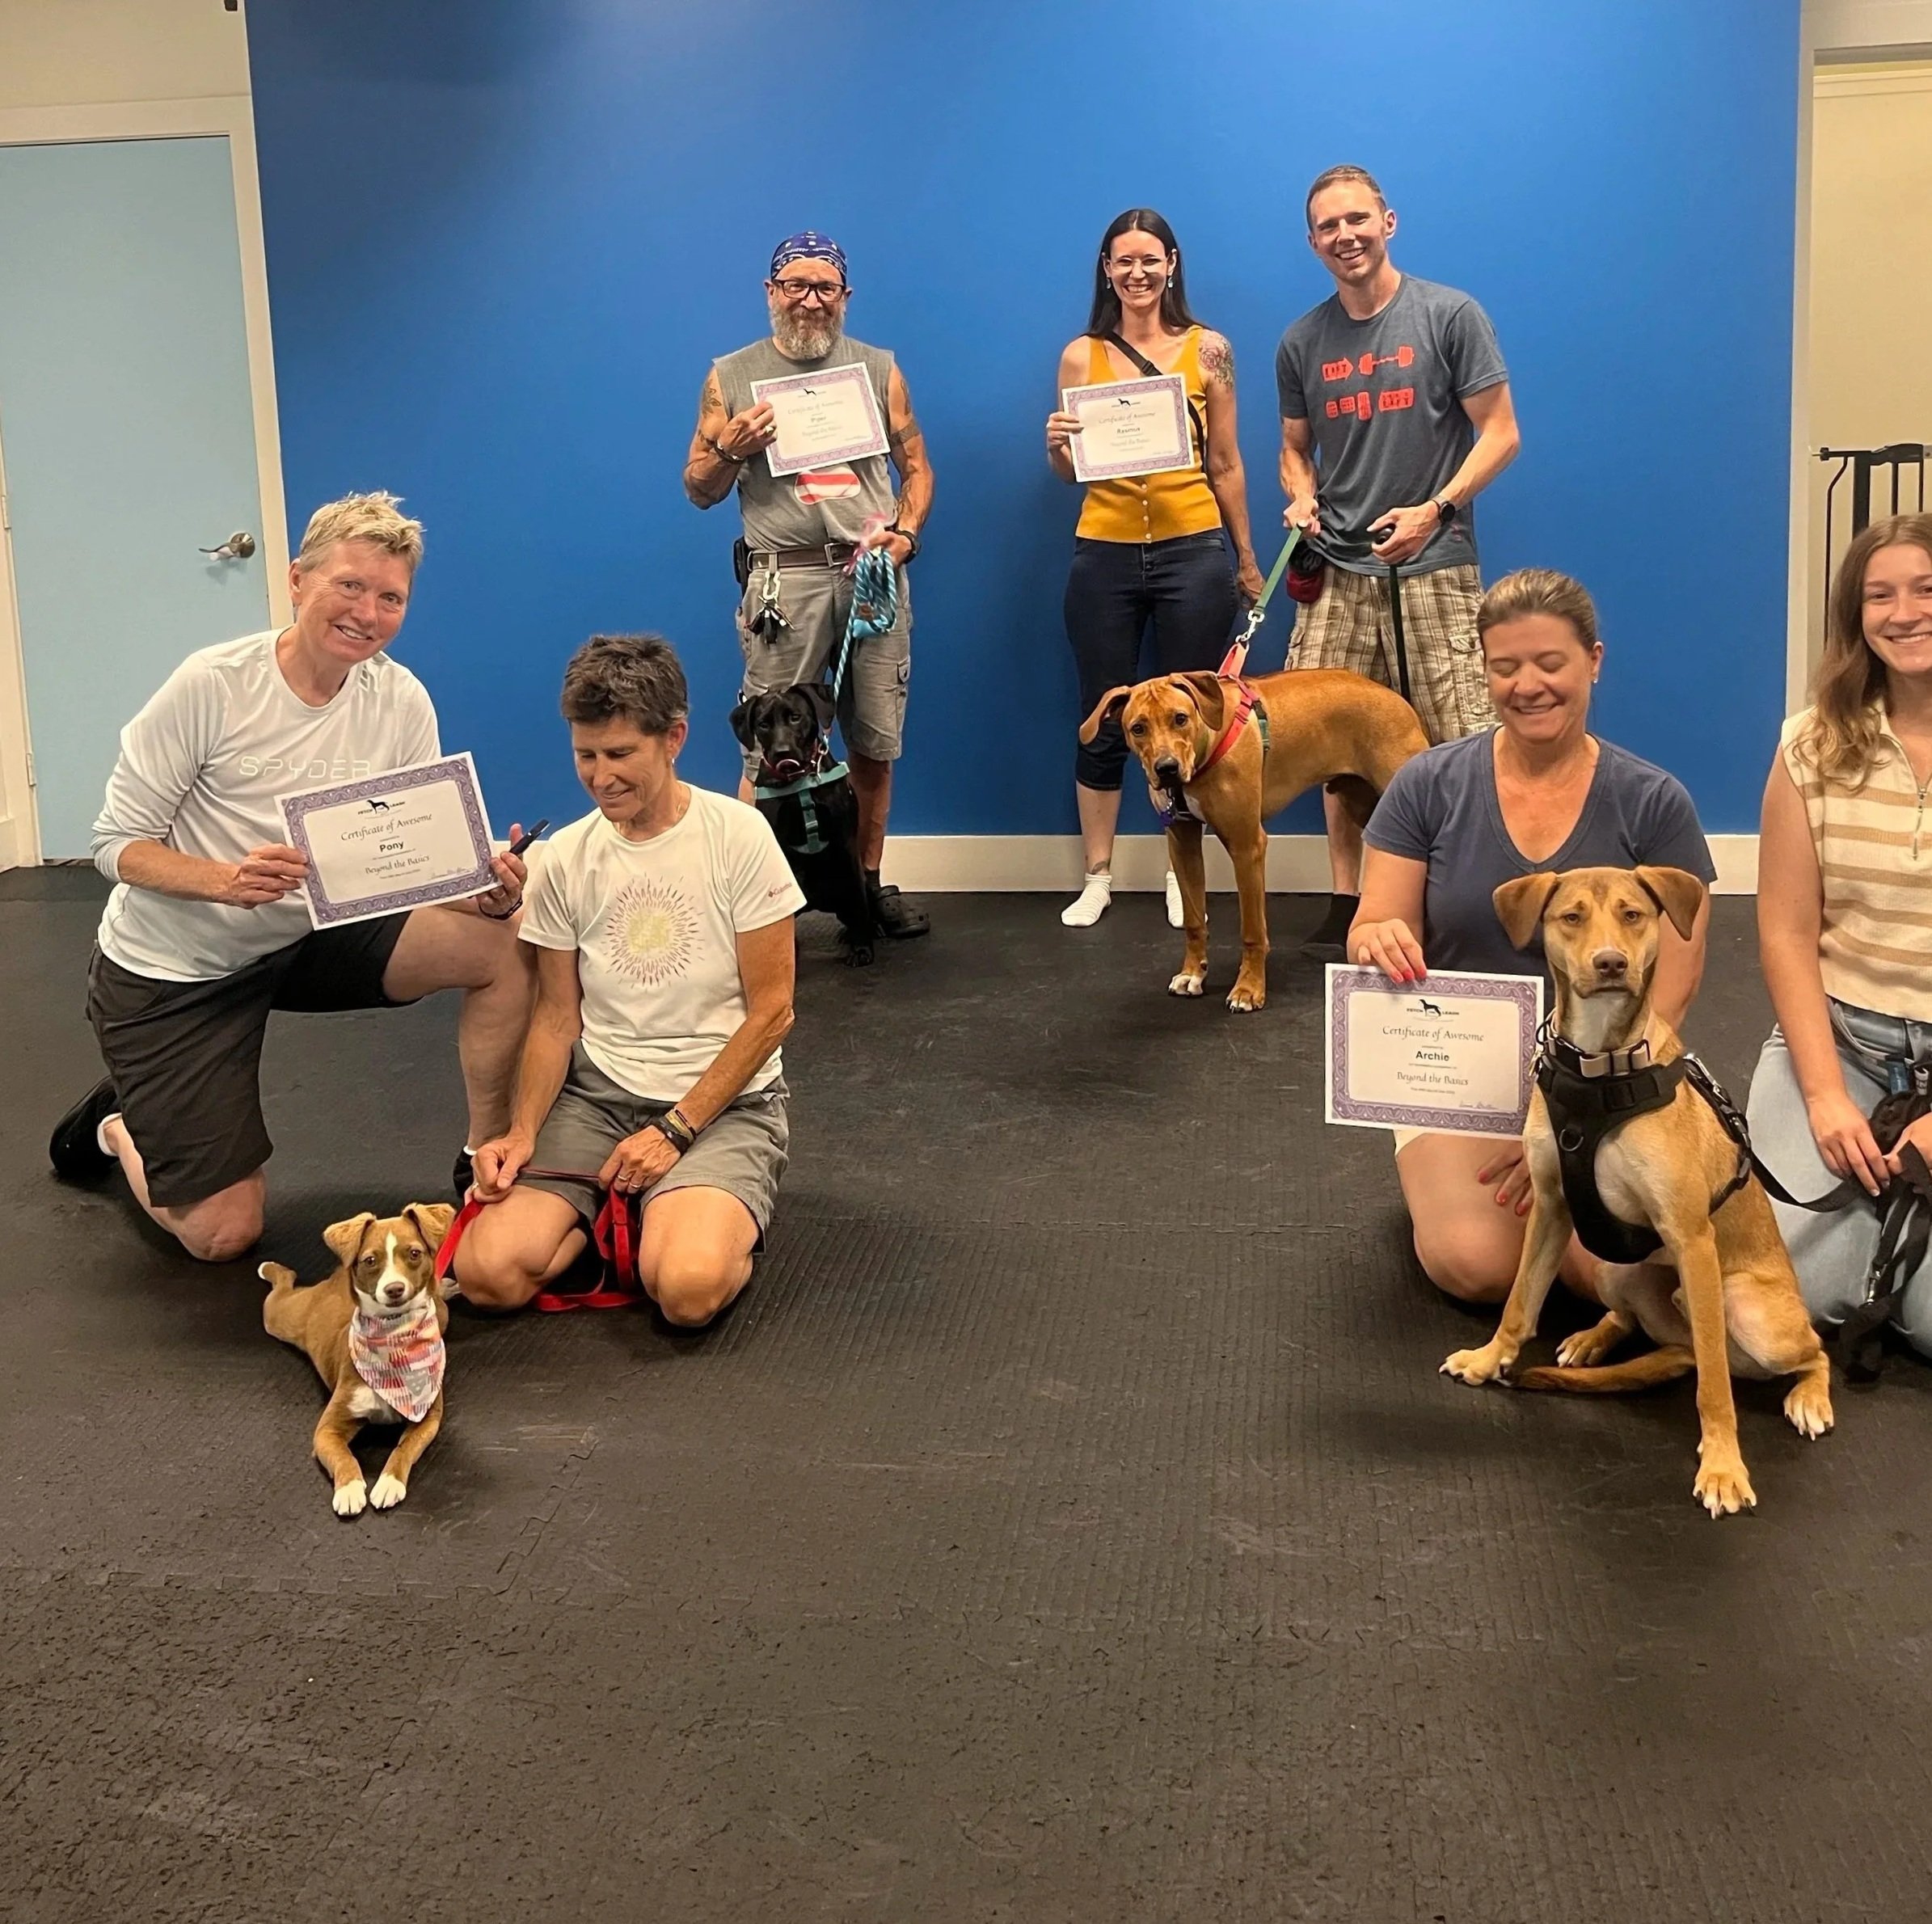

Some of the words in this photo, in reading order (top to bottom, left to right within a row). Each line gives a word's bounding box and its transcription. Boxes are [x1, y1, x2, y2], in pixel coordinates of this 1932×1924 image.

[238, 755, 371, 779] SPYDER
[340, 825, 384, 841] Certificate
[386, 818, 395, 833] of
[396, 813, 432, 829] Awesome
[379, 841, 405, 852] Pony
[365, 861, 393, 876] Beyond
[394, 859, 406, 868] the
[1382, 1025, 1429, 1040] Certificate
[1432, 1027, 1444, 1042] of
[1444, 1030, 1485, 1041] Awesome
[1415, 1050, 1449, 1061] Archie
[1397, 1071, 1427, 1084] Beyond
[1429, 1073, 1441, 1083] the
